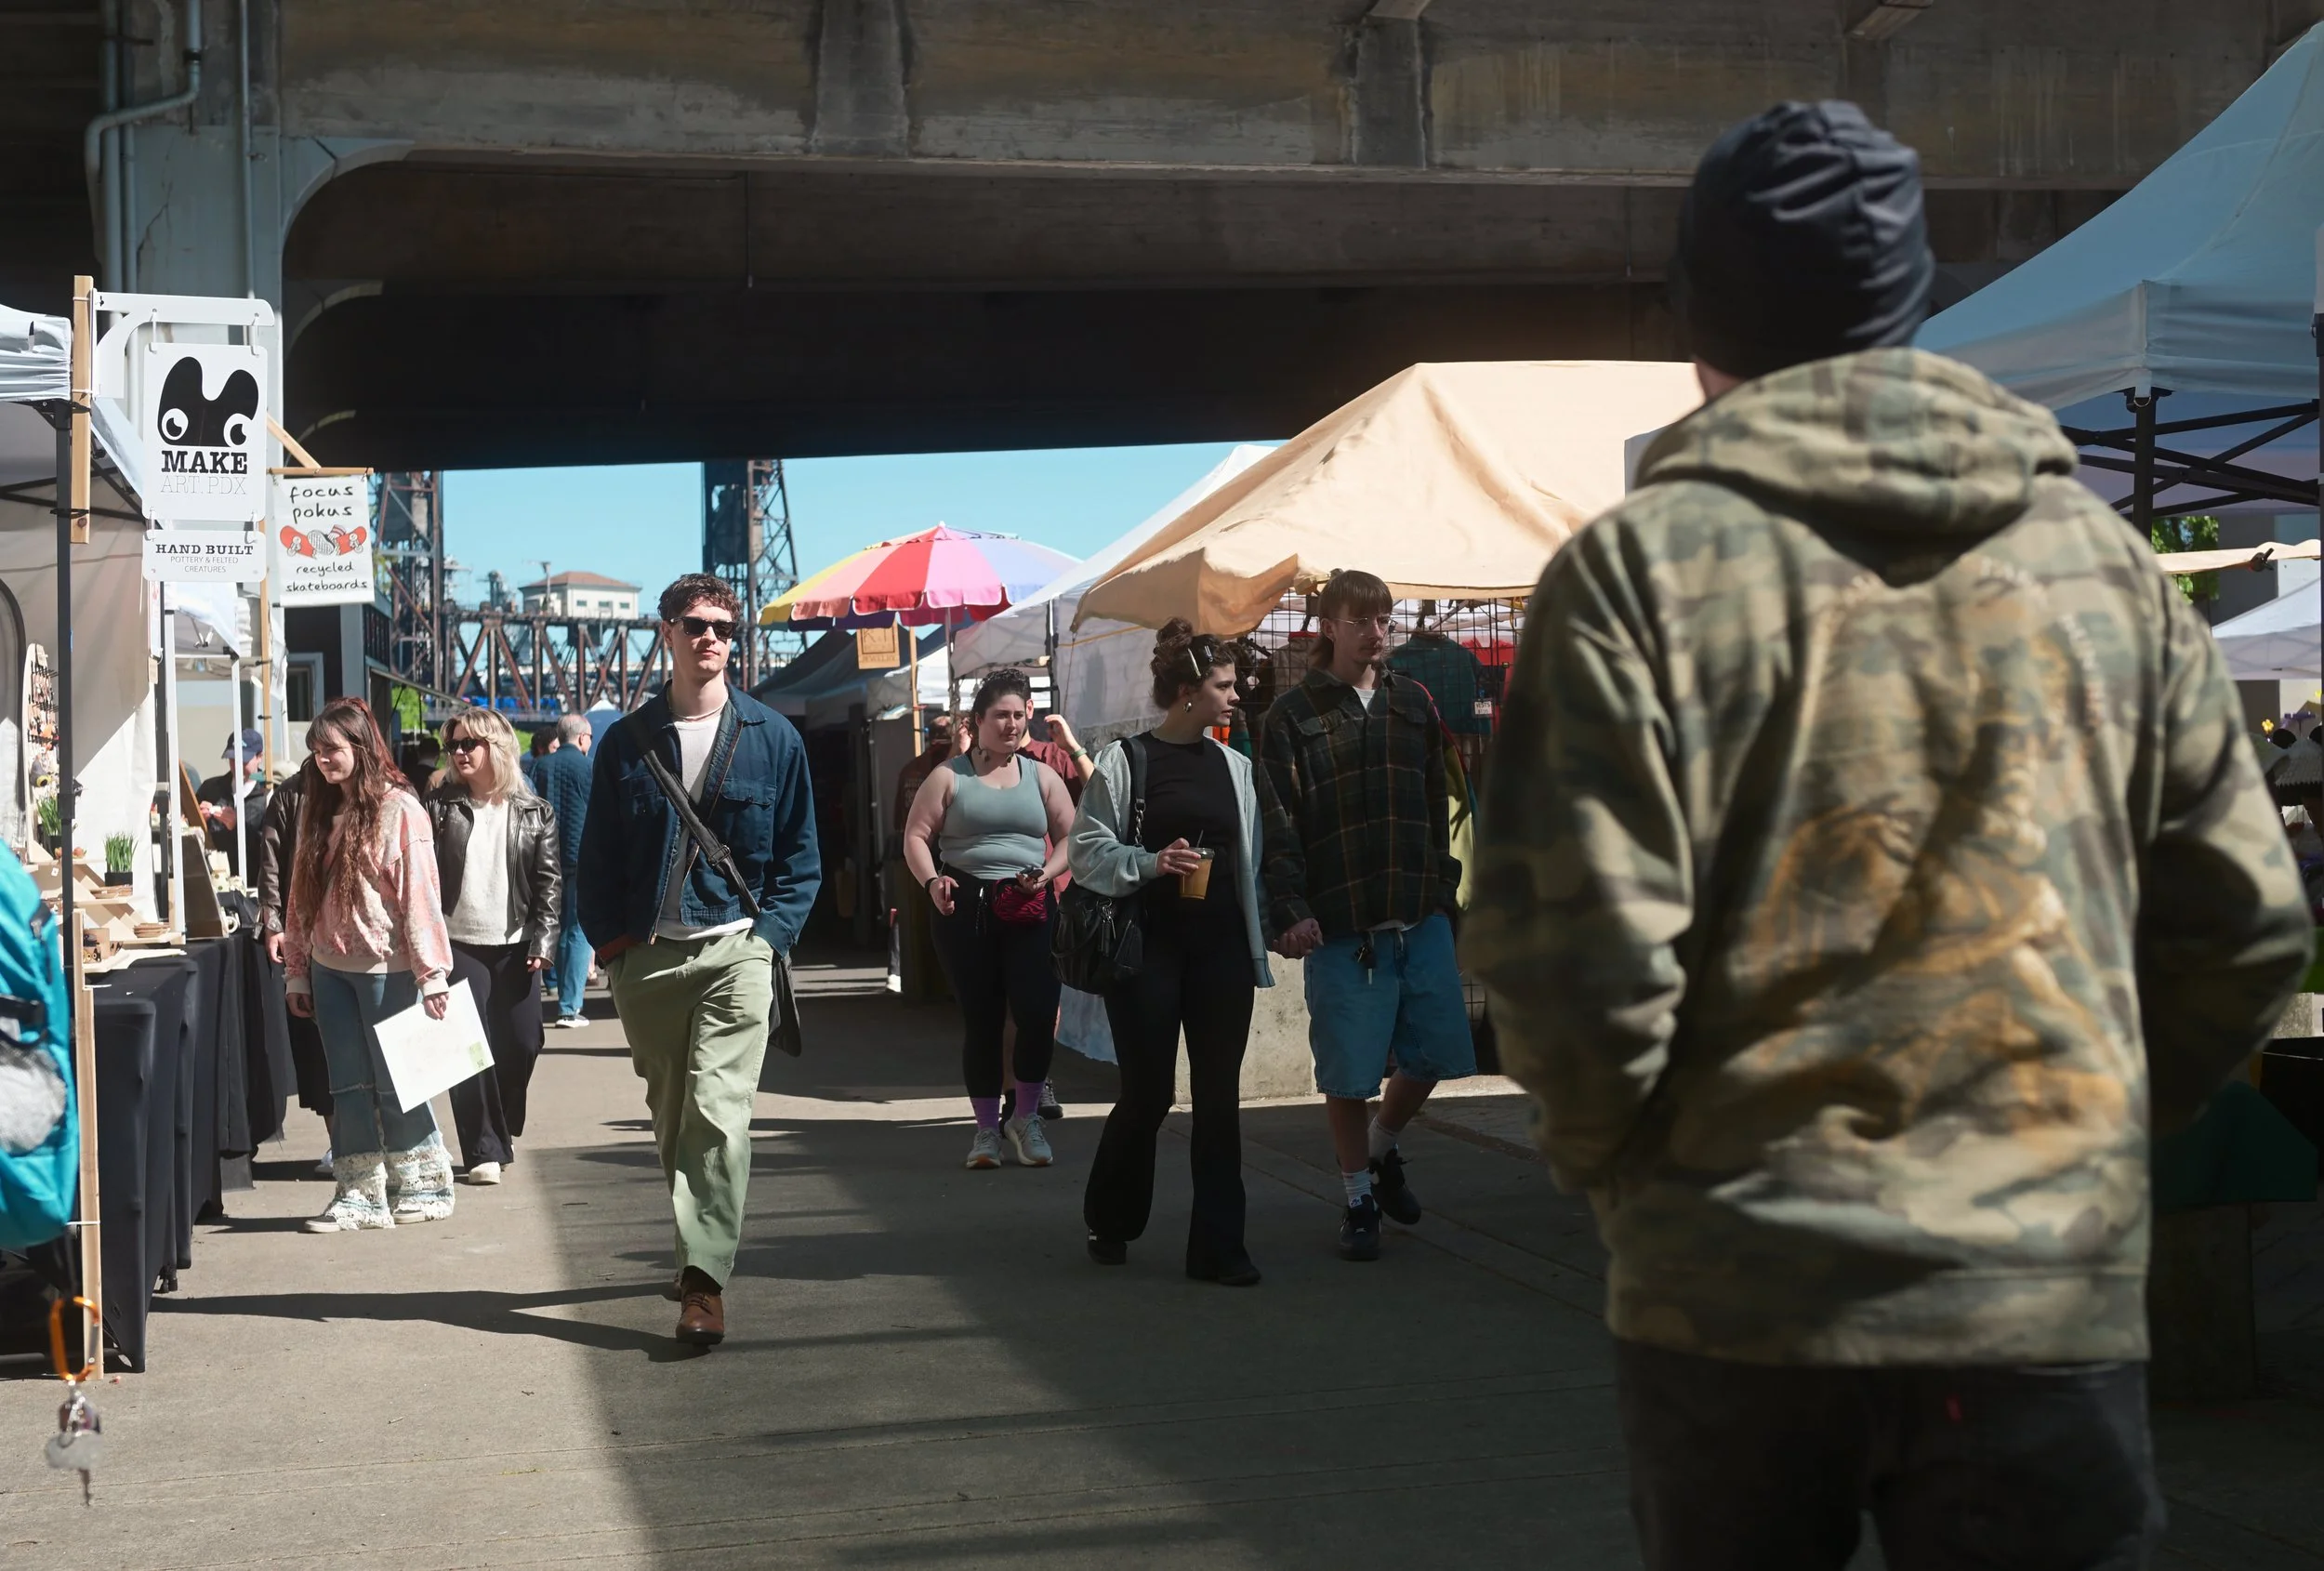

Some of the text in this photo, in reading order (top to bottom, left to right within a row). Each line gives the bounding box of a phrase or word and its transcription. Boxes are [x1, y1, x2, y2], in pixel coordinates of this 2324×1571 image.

[161, 450, 247, 474] MAKE
[290, 486, 353, 503] focus
[293, 503, 352, 523] pokus
[155, 544, 253, 555] HAND BUILT
[184, 565, 227, 574] CREATURES
[297, 561, 354, 577] recycled
[285, 579, 368, 592] skateboards
